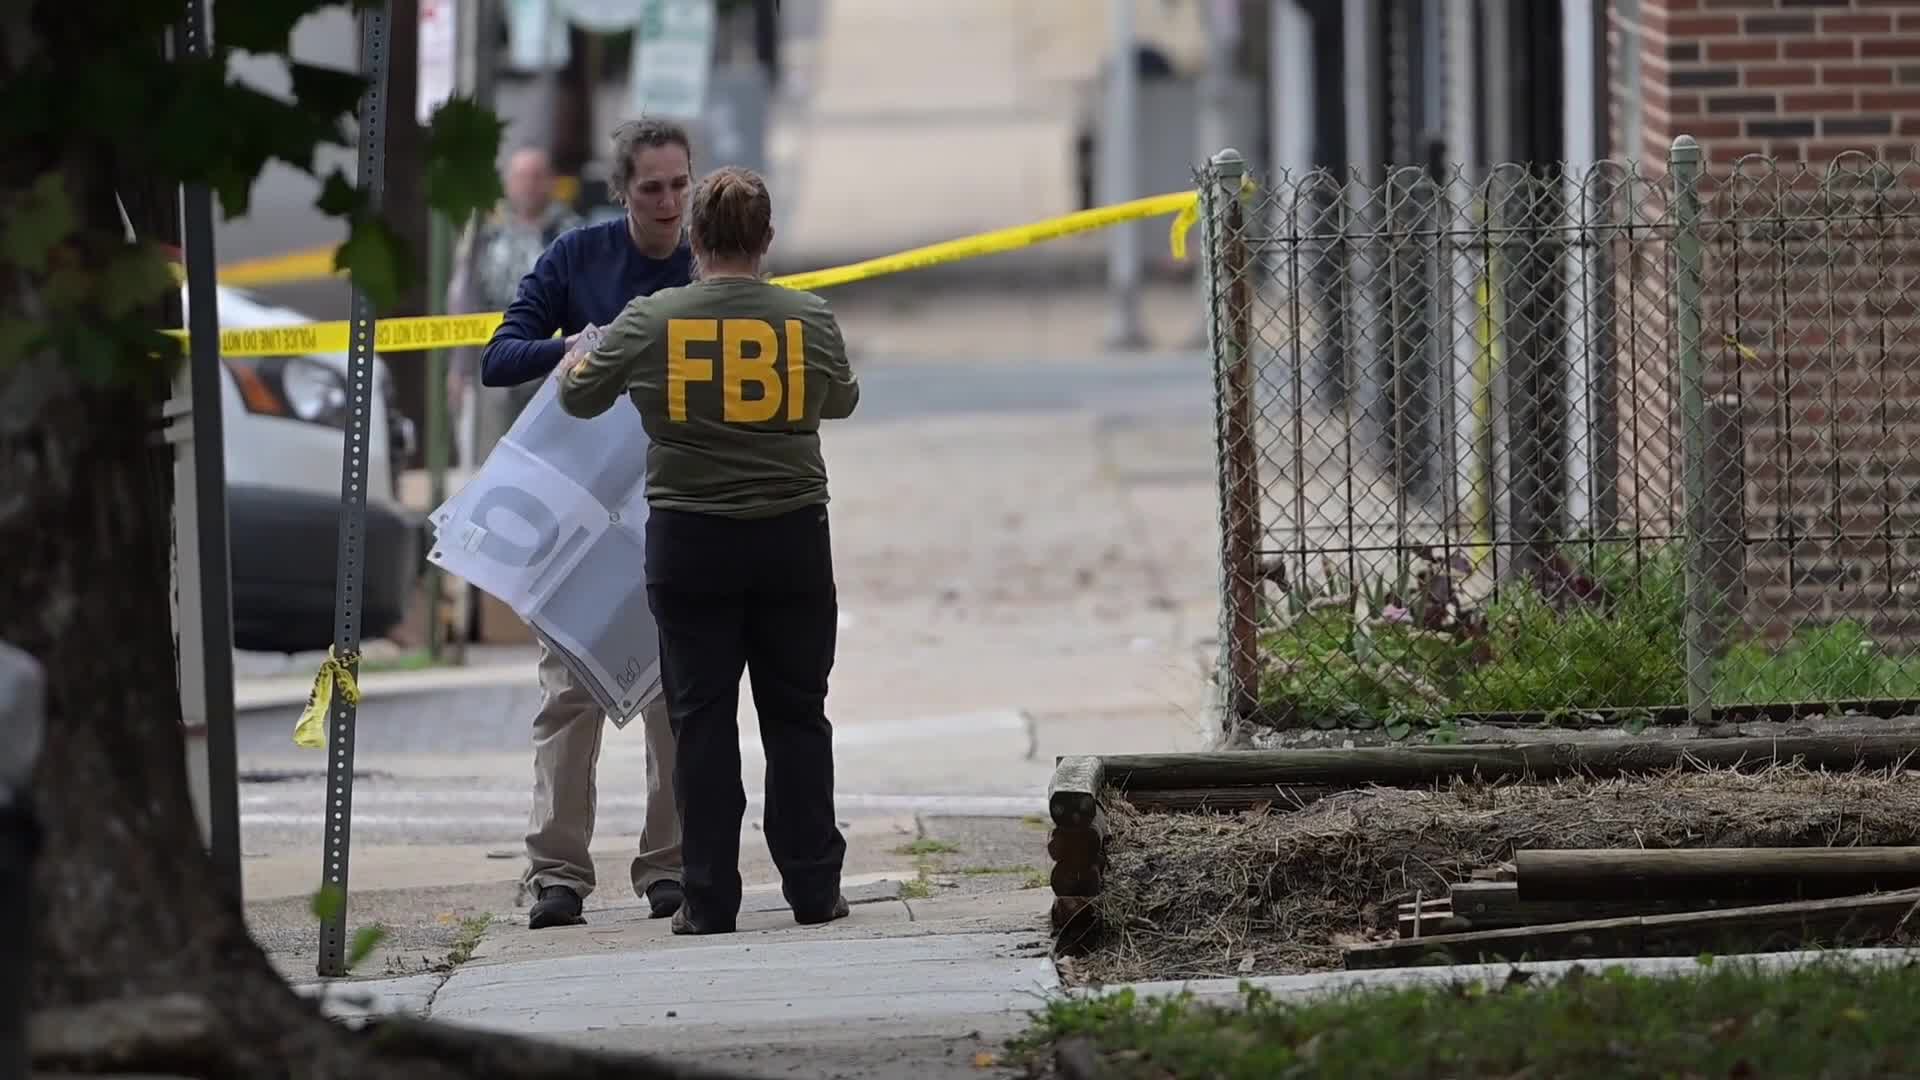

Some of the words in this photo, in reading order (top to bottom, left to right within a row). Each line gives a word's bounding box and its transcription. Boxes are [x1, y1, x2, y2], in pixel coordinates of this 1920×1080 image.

[243, 329, 257, 350] DO
[259, 328, 281, 349] LINE
[283, 327, 316, 349] POLICE
[394, 324, 411, 344] NOT
[414, 322, 427, 344] DO
[430, 321, 451, 342] LINE
[454, 319, 487, 340] POLICE
[222, 330, 241, 351] NOT
[667, 319, 805, 422] FBI
